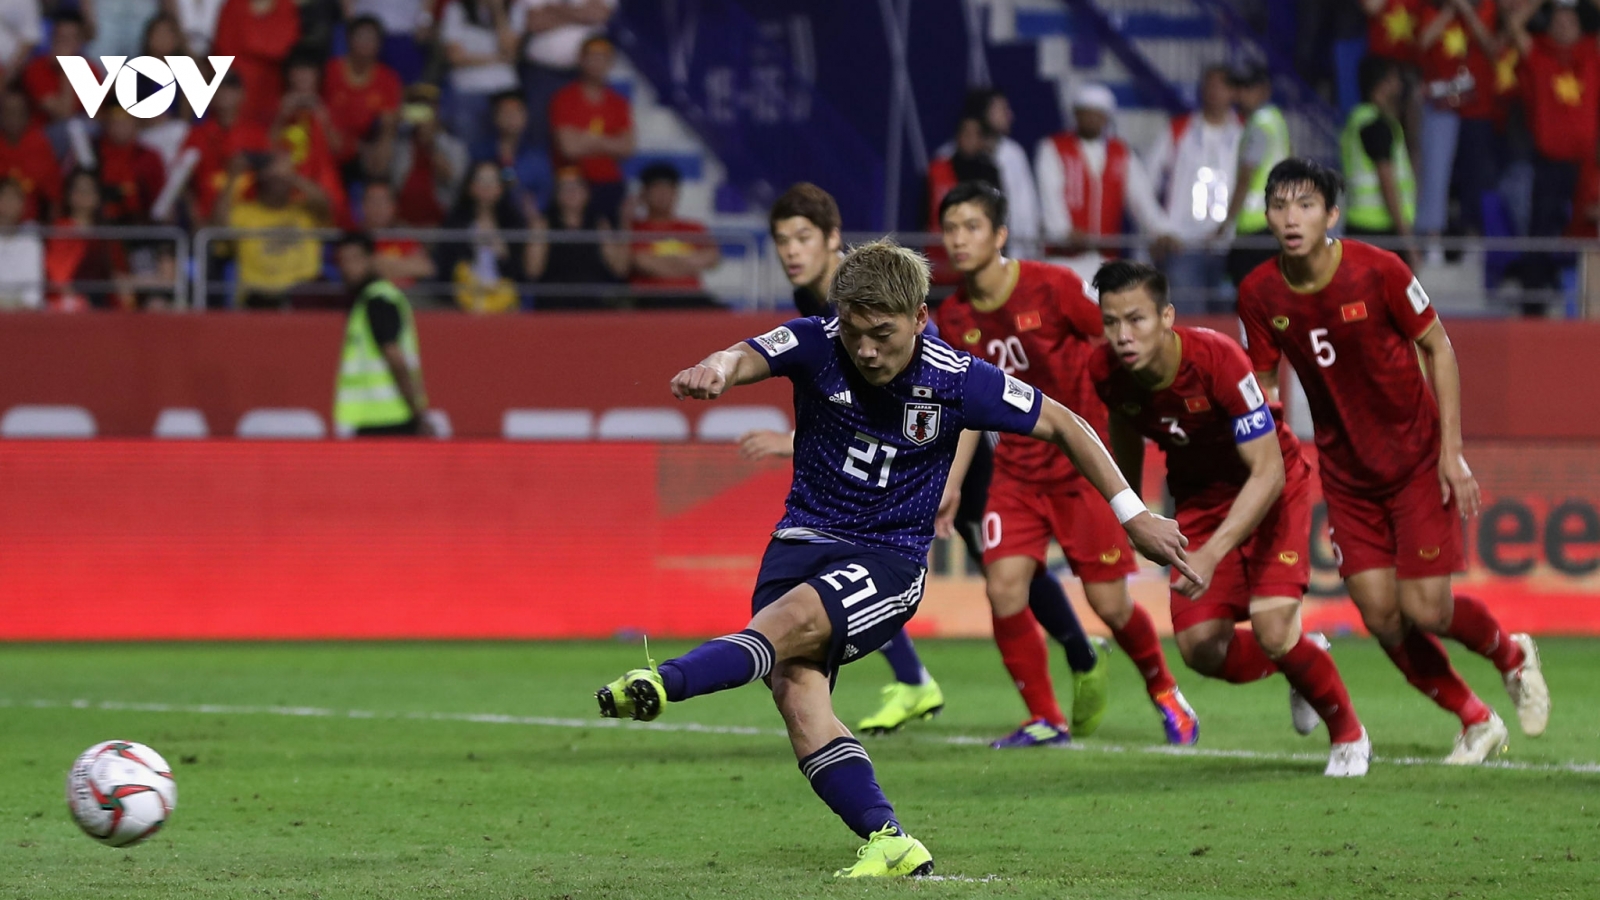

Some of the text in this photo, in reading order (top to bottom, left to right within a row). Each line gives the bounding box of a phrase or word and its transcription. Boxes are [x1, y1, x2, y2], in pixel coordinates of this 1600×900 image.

[987, 336, 1029, 375] 20
[1309, 328, 1336, 367] 5
[1161, 417, 1190, 445] 3
[1235, 411, 1267, 436] AFC
[843, 431, 897, 488] 21
[820, 563, 878, 608] 21
